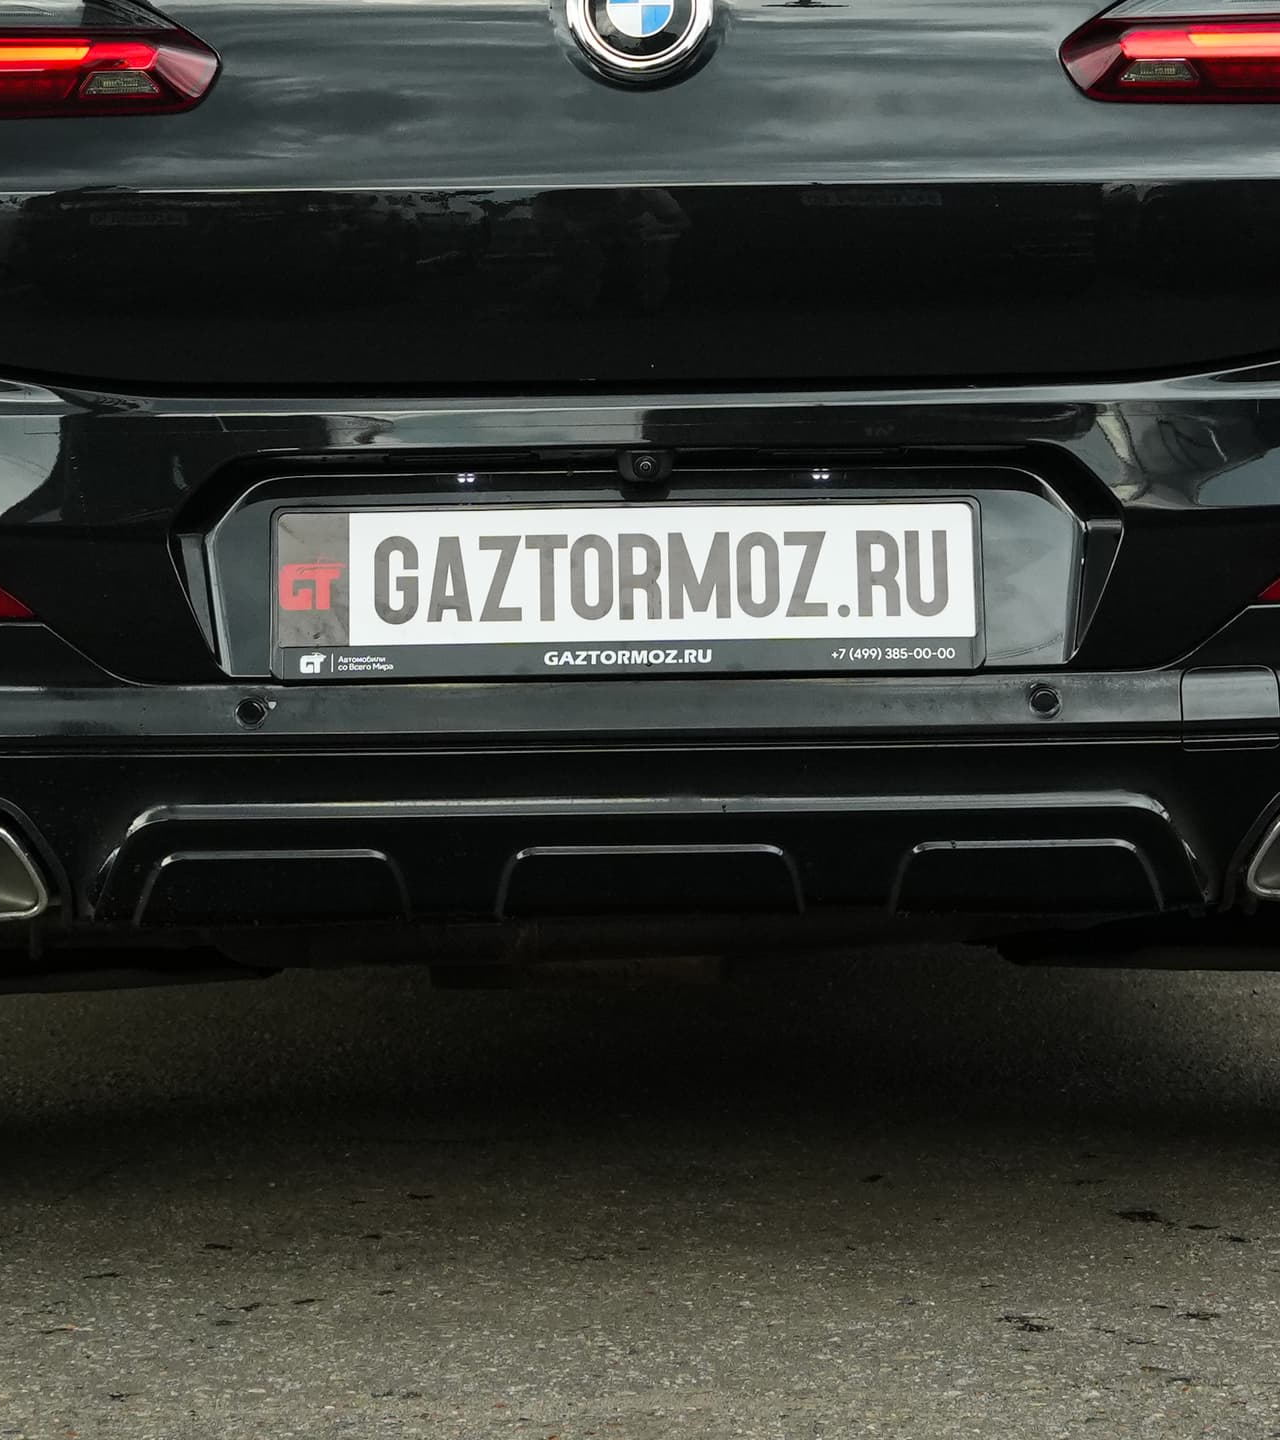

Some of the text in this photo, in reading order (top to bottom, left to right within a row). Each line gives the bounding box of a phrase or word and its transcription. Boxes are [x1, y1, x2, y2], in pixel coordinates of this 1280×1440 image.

[279, 560, 344, 611] GT
[373, 529, 950, 626] GAZTORMOZ.RU
[299, 652, 326, 674] GT
[337, 655, 386, 664] Автомобили
[543, 648, 713, 666] GAZTORMOZ.RU
[831, 647, 956, 661] +7 (499) 385-00-00
[337, 662, 395, 672] со Всего Мира
